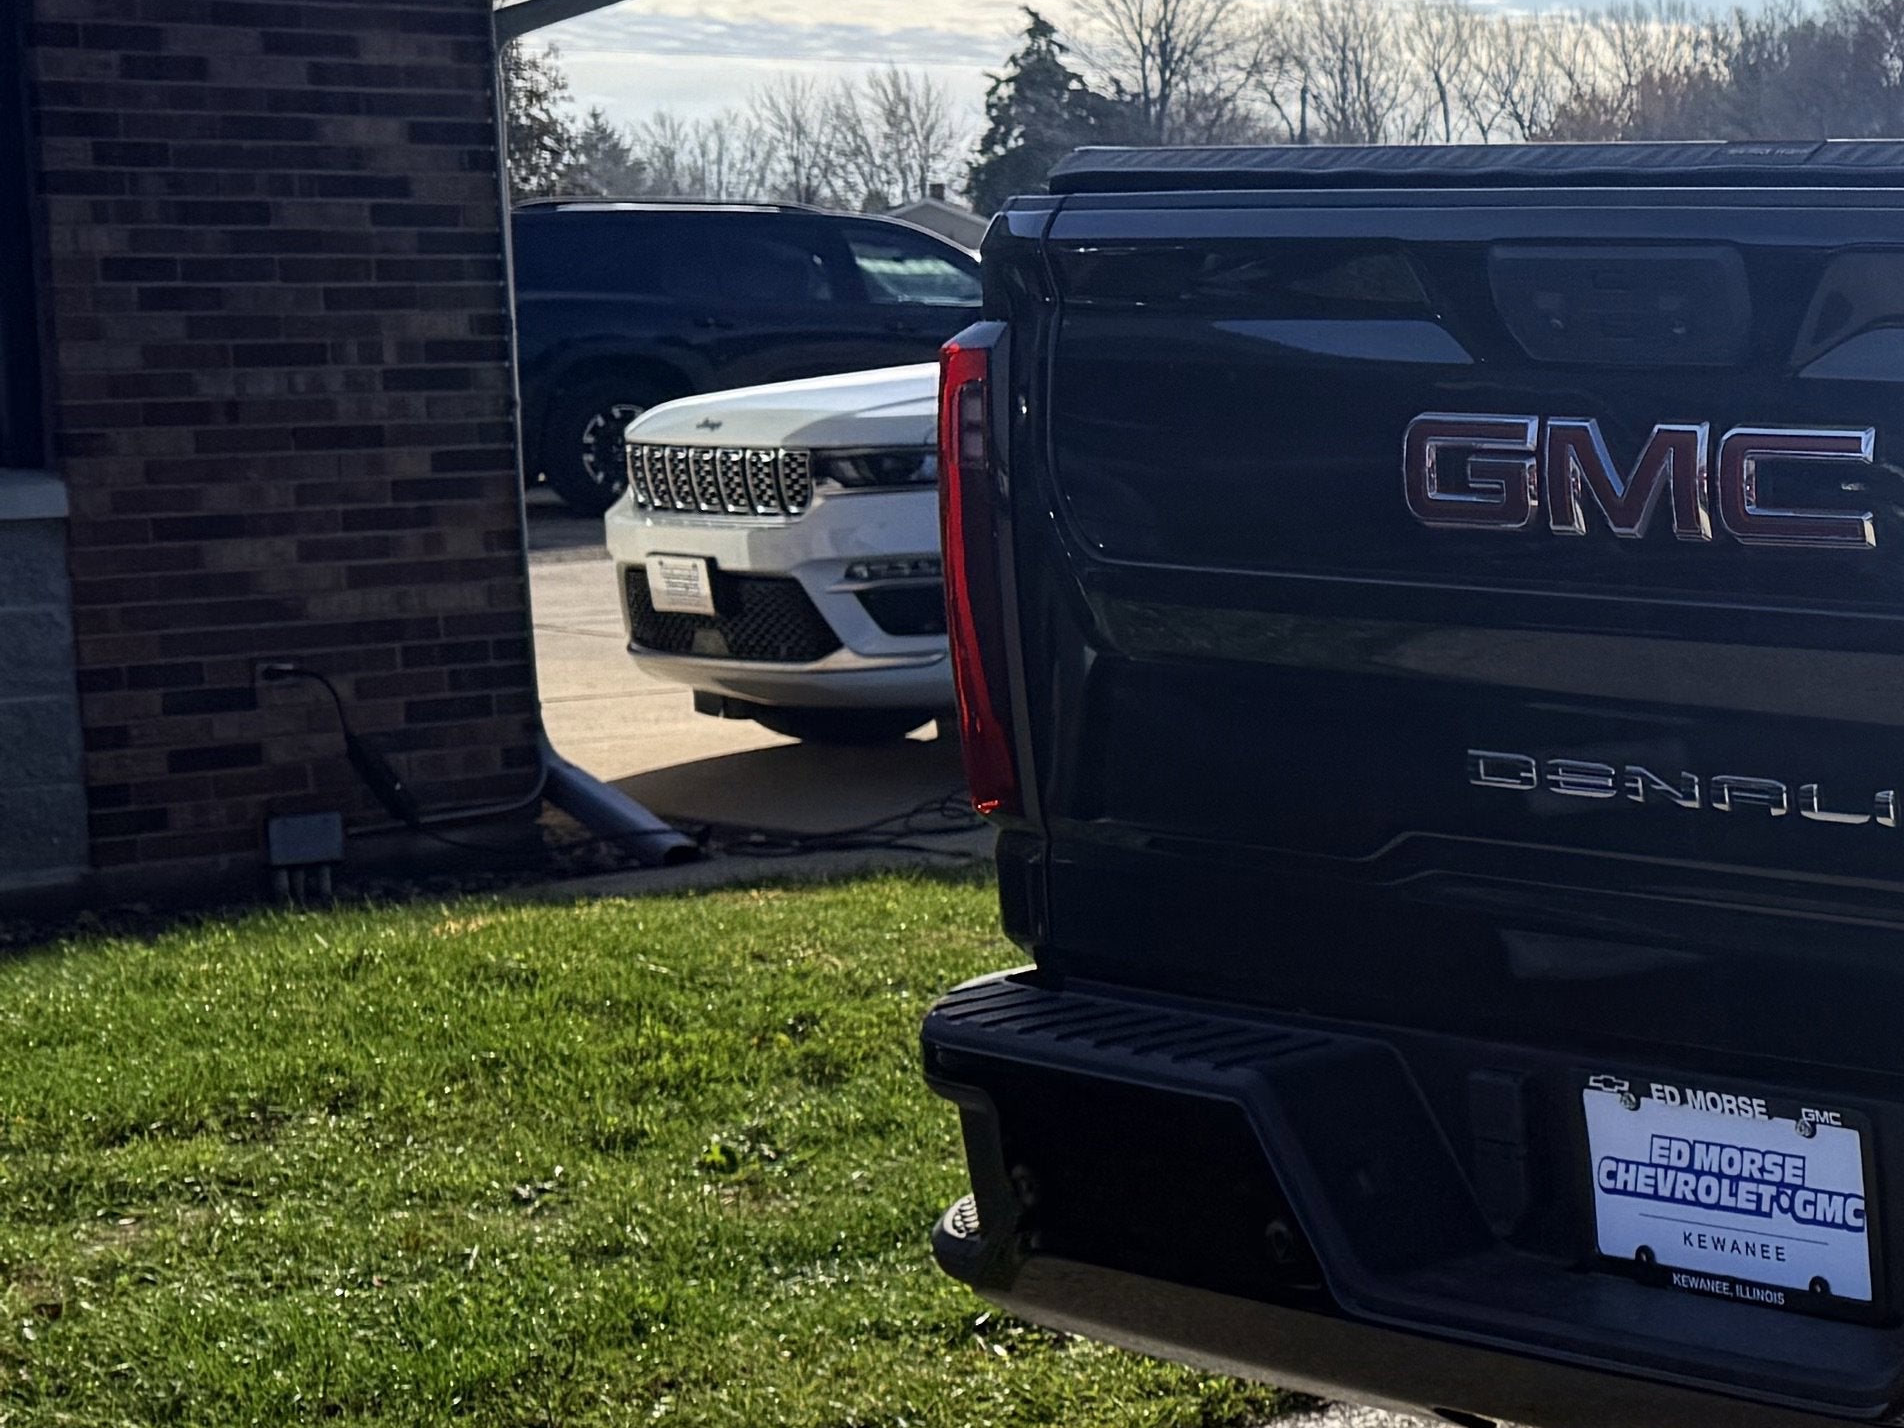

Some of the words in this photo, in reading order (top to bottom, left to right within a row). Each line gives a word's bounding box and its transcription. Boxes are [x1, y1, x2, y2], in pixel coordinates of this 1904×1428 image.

[1402, 410, 1877, 549] GMC
[1467, 747, 1899, 828] DENALI
[1650, 1082, 1681, 1107] ED
[1686, 1086, 1769, 1121] MORSE
[1801, 1107, 1842, 1126] GMC
[1650, 1135, 1692, 1169] ED
[1693, 1140, 1806, 1185] MORSE
[1682, 1230, 1787, 1262] KEWANEE
[1672, 1272, 1734, 1298] KEWANEE,
[1735, 1283, 1786, 1305] ILLINOIS
